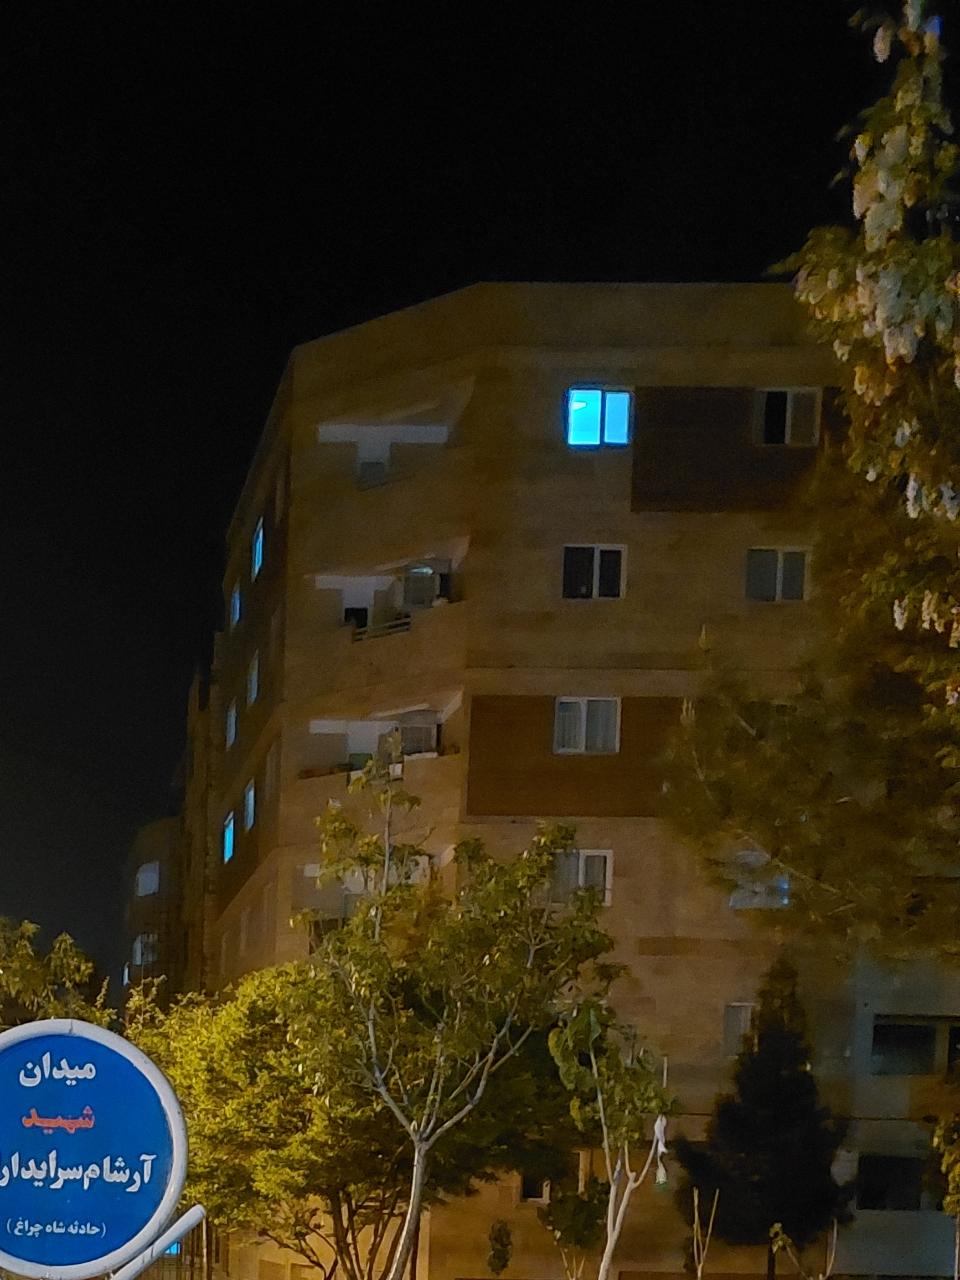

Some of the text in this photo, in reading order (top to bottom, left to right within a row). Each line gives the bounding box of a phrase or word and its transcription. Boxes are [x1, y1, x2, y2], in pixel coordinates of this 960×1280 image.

[18, 1051, 97, 1087] میدان
[21, 1105, 96, 1133] شهید
[83, 1154, 158, 1193] آرشام
[45, 1222, 66, 1235] شاه
